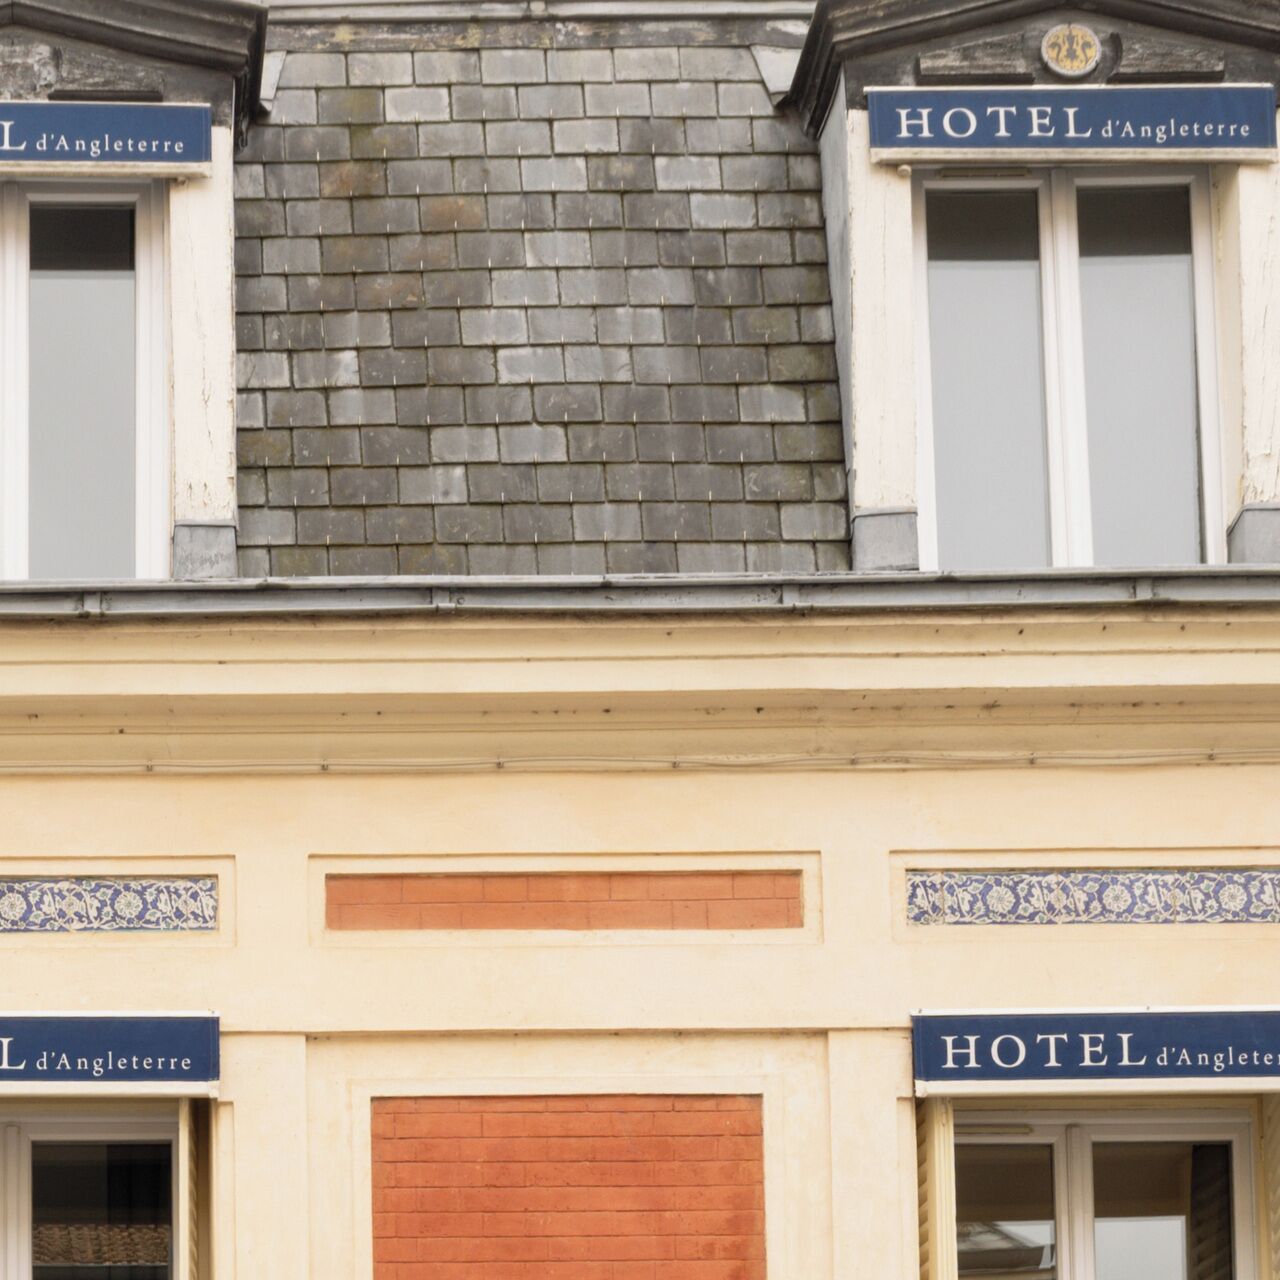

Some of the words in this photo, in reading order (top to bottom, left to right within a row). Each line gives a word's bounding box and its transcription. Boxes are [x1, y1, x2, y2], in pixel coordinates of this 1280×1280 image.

[896, 106, 1092, 138] HOTEL
[1101, 118, 1250, 144] d'Angleterre
[35, 133, 184, 158] d'Angleterre
[36, 1051, 191, 1077] d'Angleterre
[940, 1033, 1147, 1068] HOTEL
